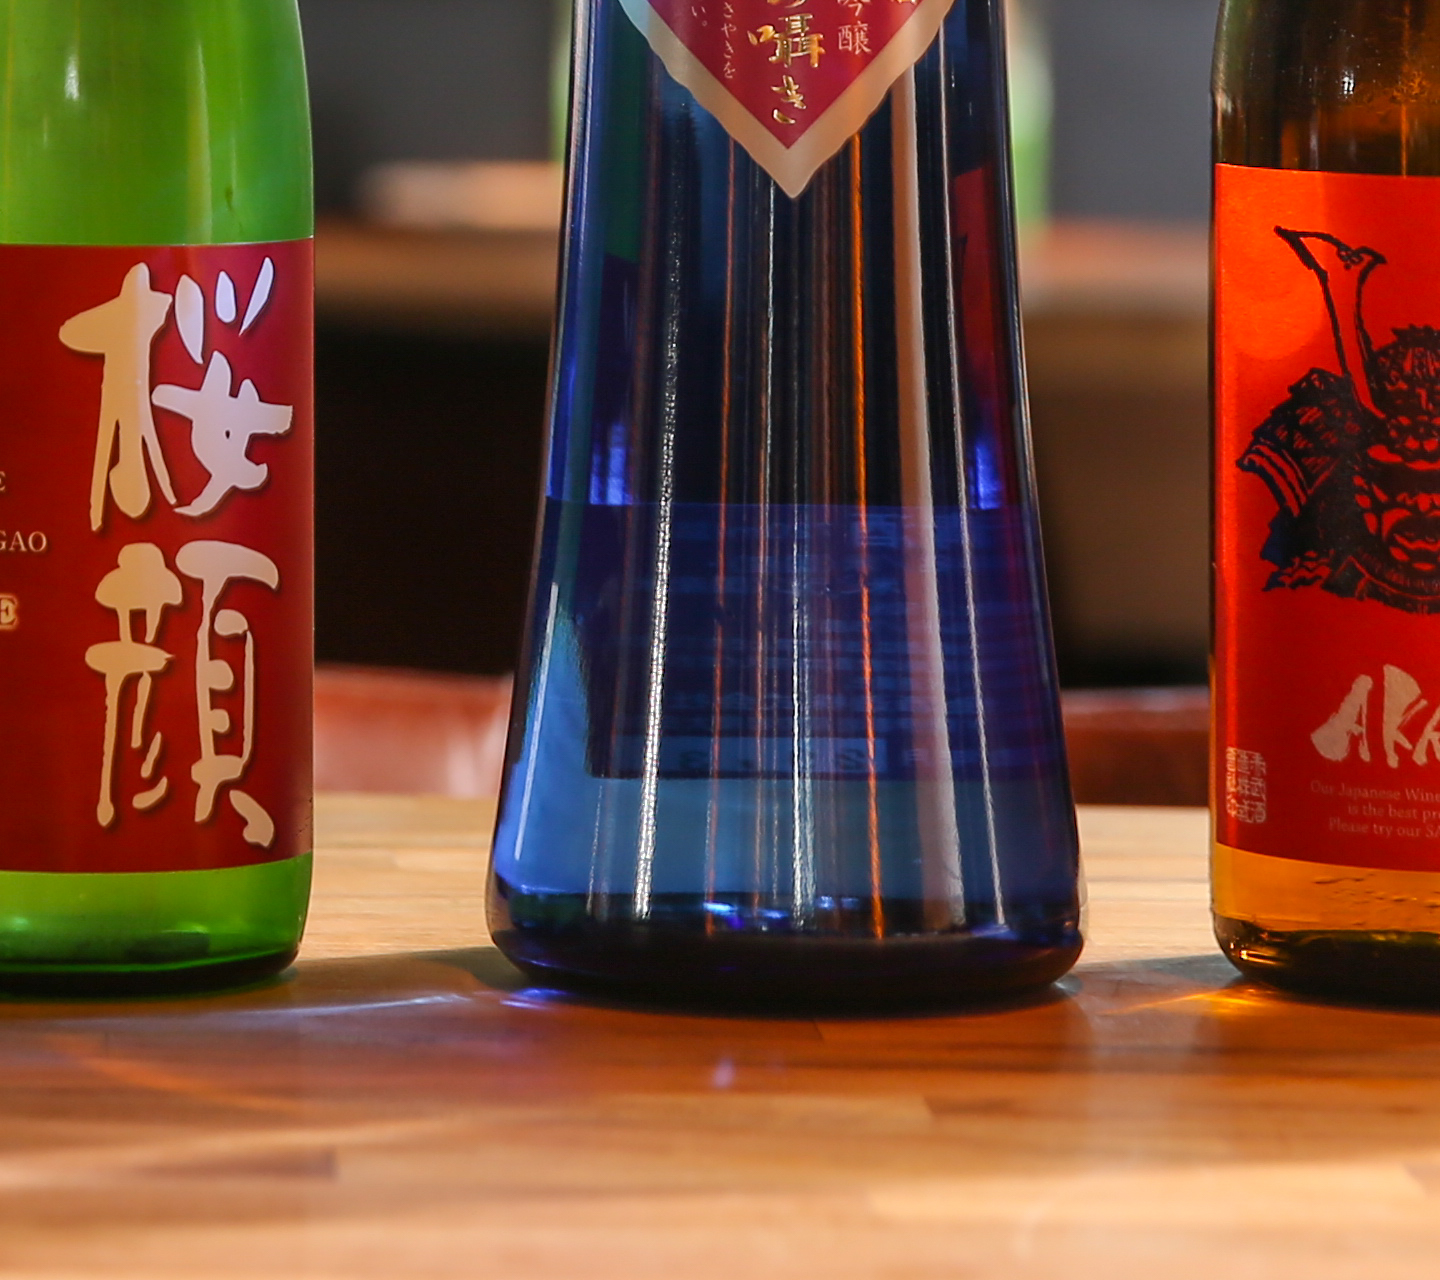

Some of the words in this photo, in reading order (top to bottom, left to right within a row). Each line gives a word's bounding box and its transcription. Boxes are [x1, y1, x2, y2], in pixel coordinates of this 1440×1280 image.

[58, 256, 294, 849] 桜顔
[1338, 783, 1401, 802] Japanese
[1347, 803, 1359, 816] is
[1363, 804, 1385, 817] the
[1388, 806, 1417, 820] best
[1328, 817, 1371, 834] Please
[1373, 823, 1393, 838] try
[1397, 826, 1421, 838] our
